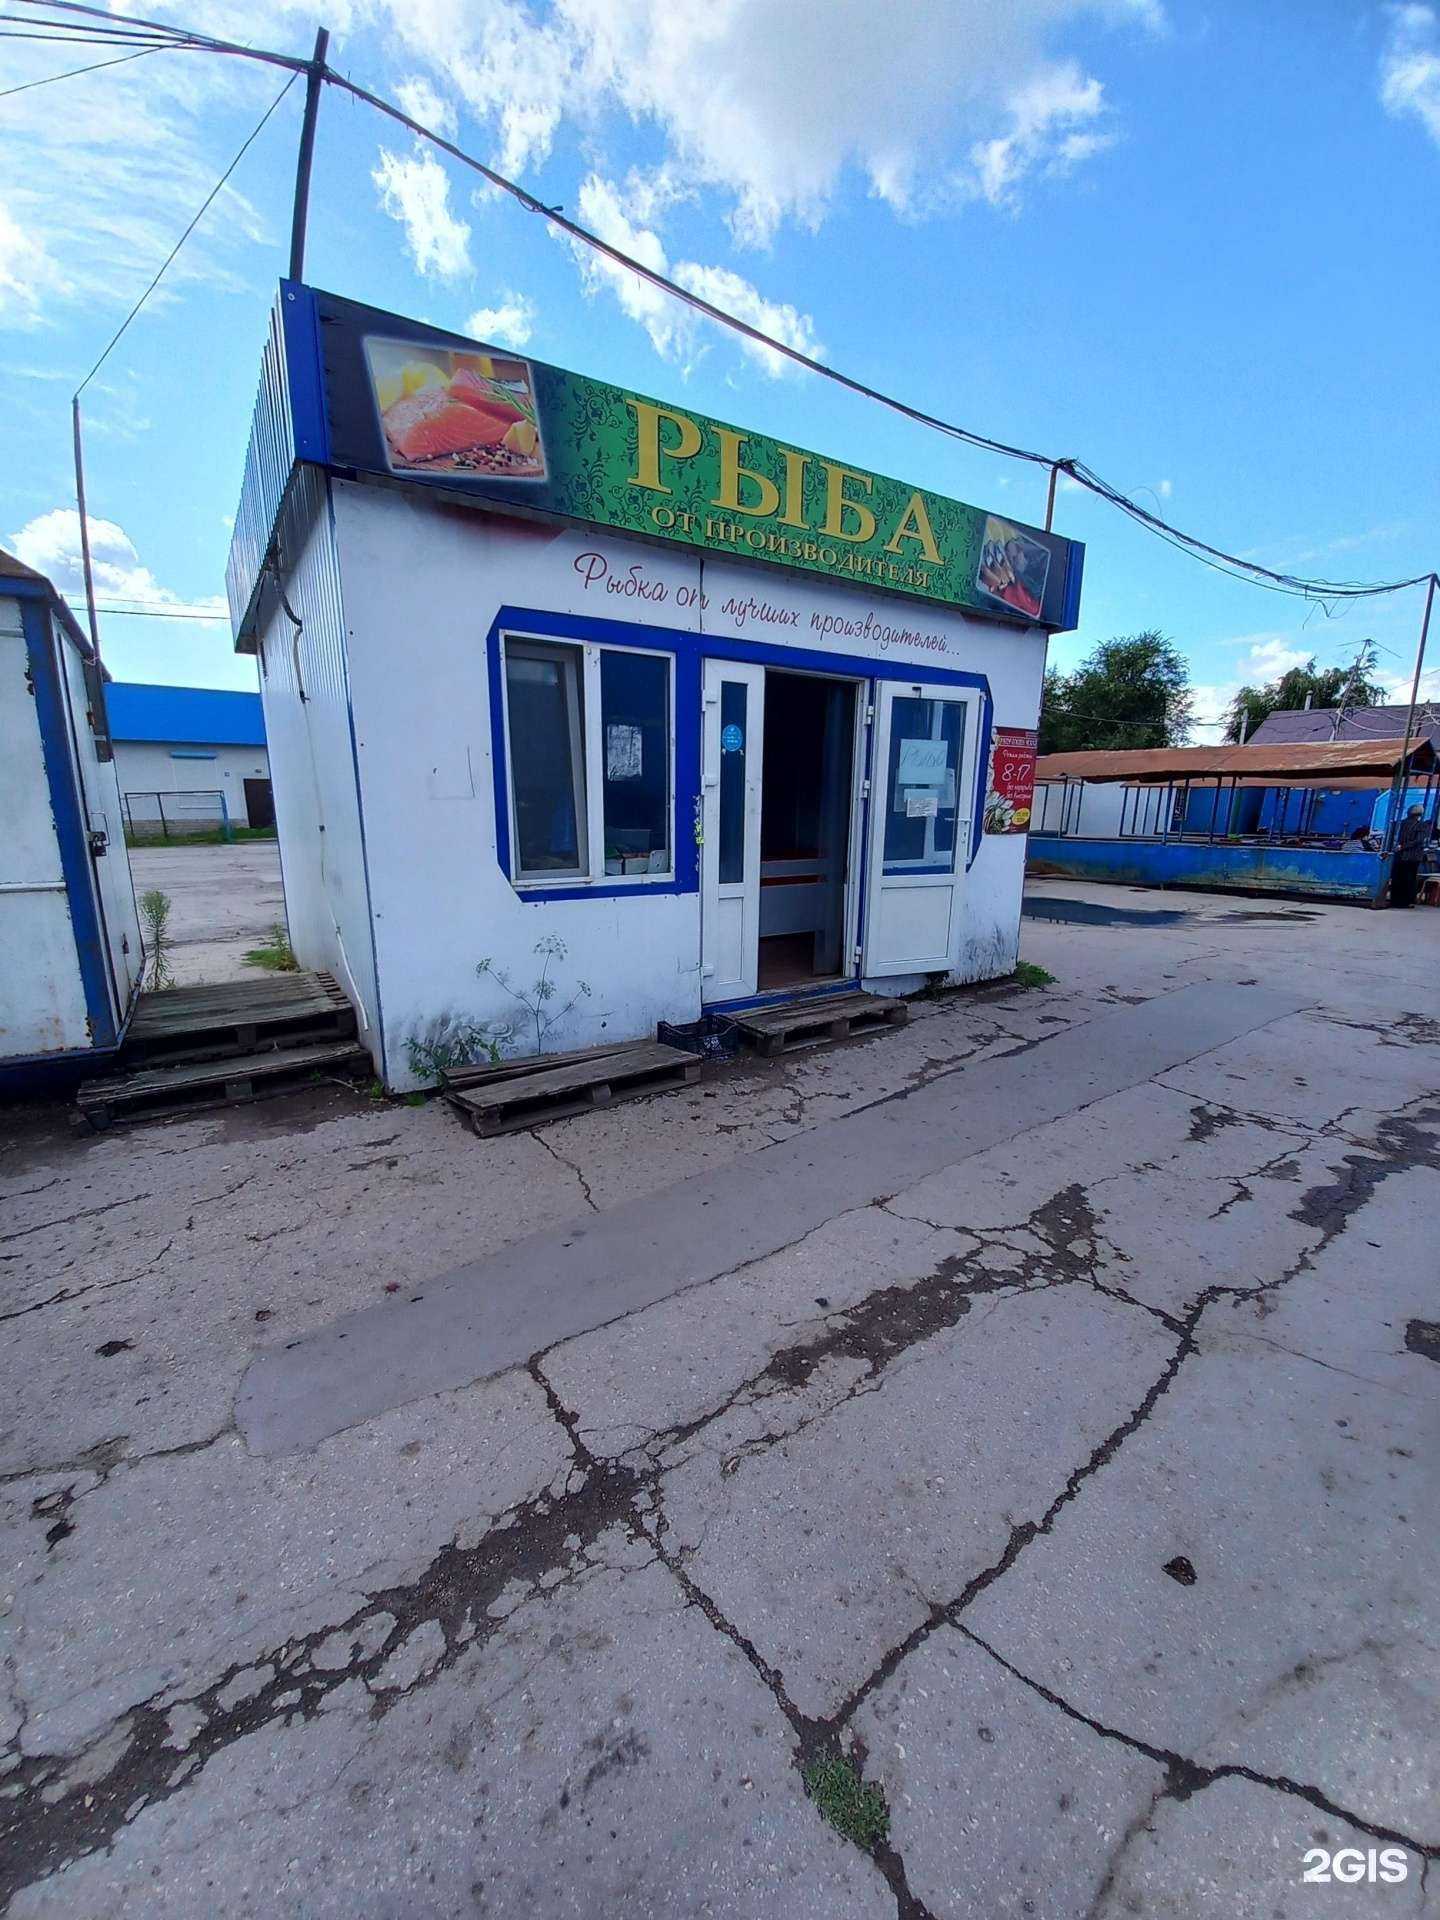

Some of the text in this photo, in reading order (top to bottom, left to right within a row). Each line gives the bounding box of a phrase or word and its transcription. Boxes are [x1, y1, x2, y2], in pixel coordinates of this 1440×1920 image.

[626, 399, 945, 566] РЫБА
[651, 506, 930, 588] ОТ ПРОИЗВОДИТЕЛЯ
[573, 552, 669, 602] Рыбка
[675, 585, 710, 610] от
[720, 598, 800, 628] лучших
